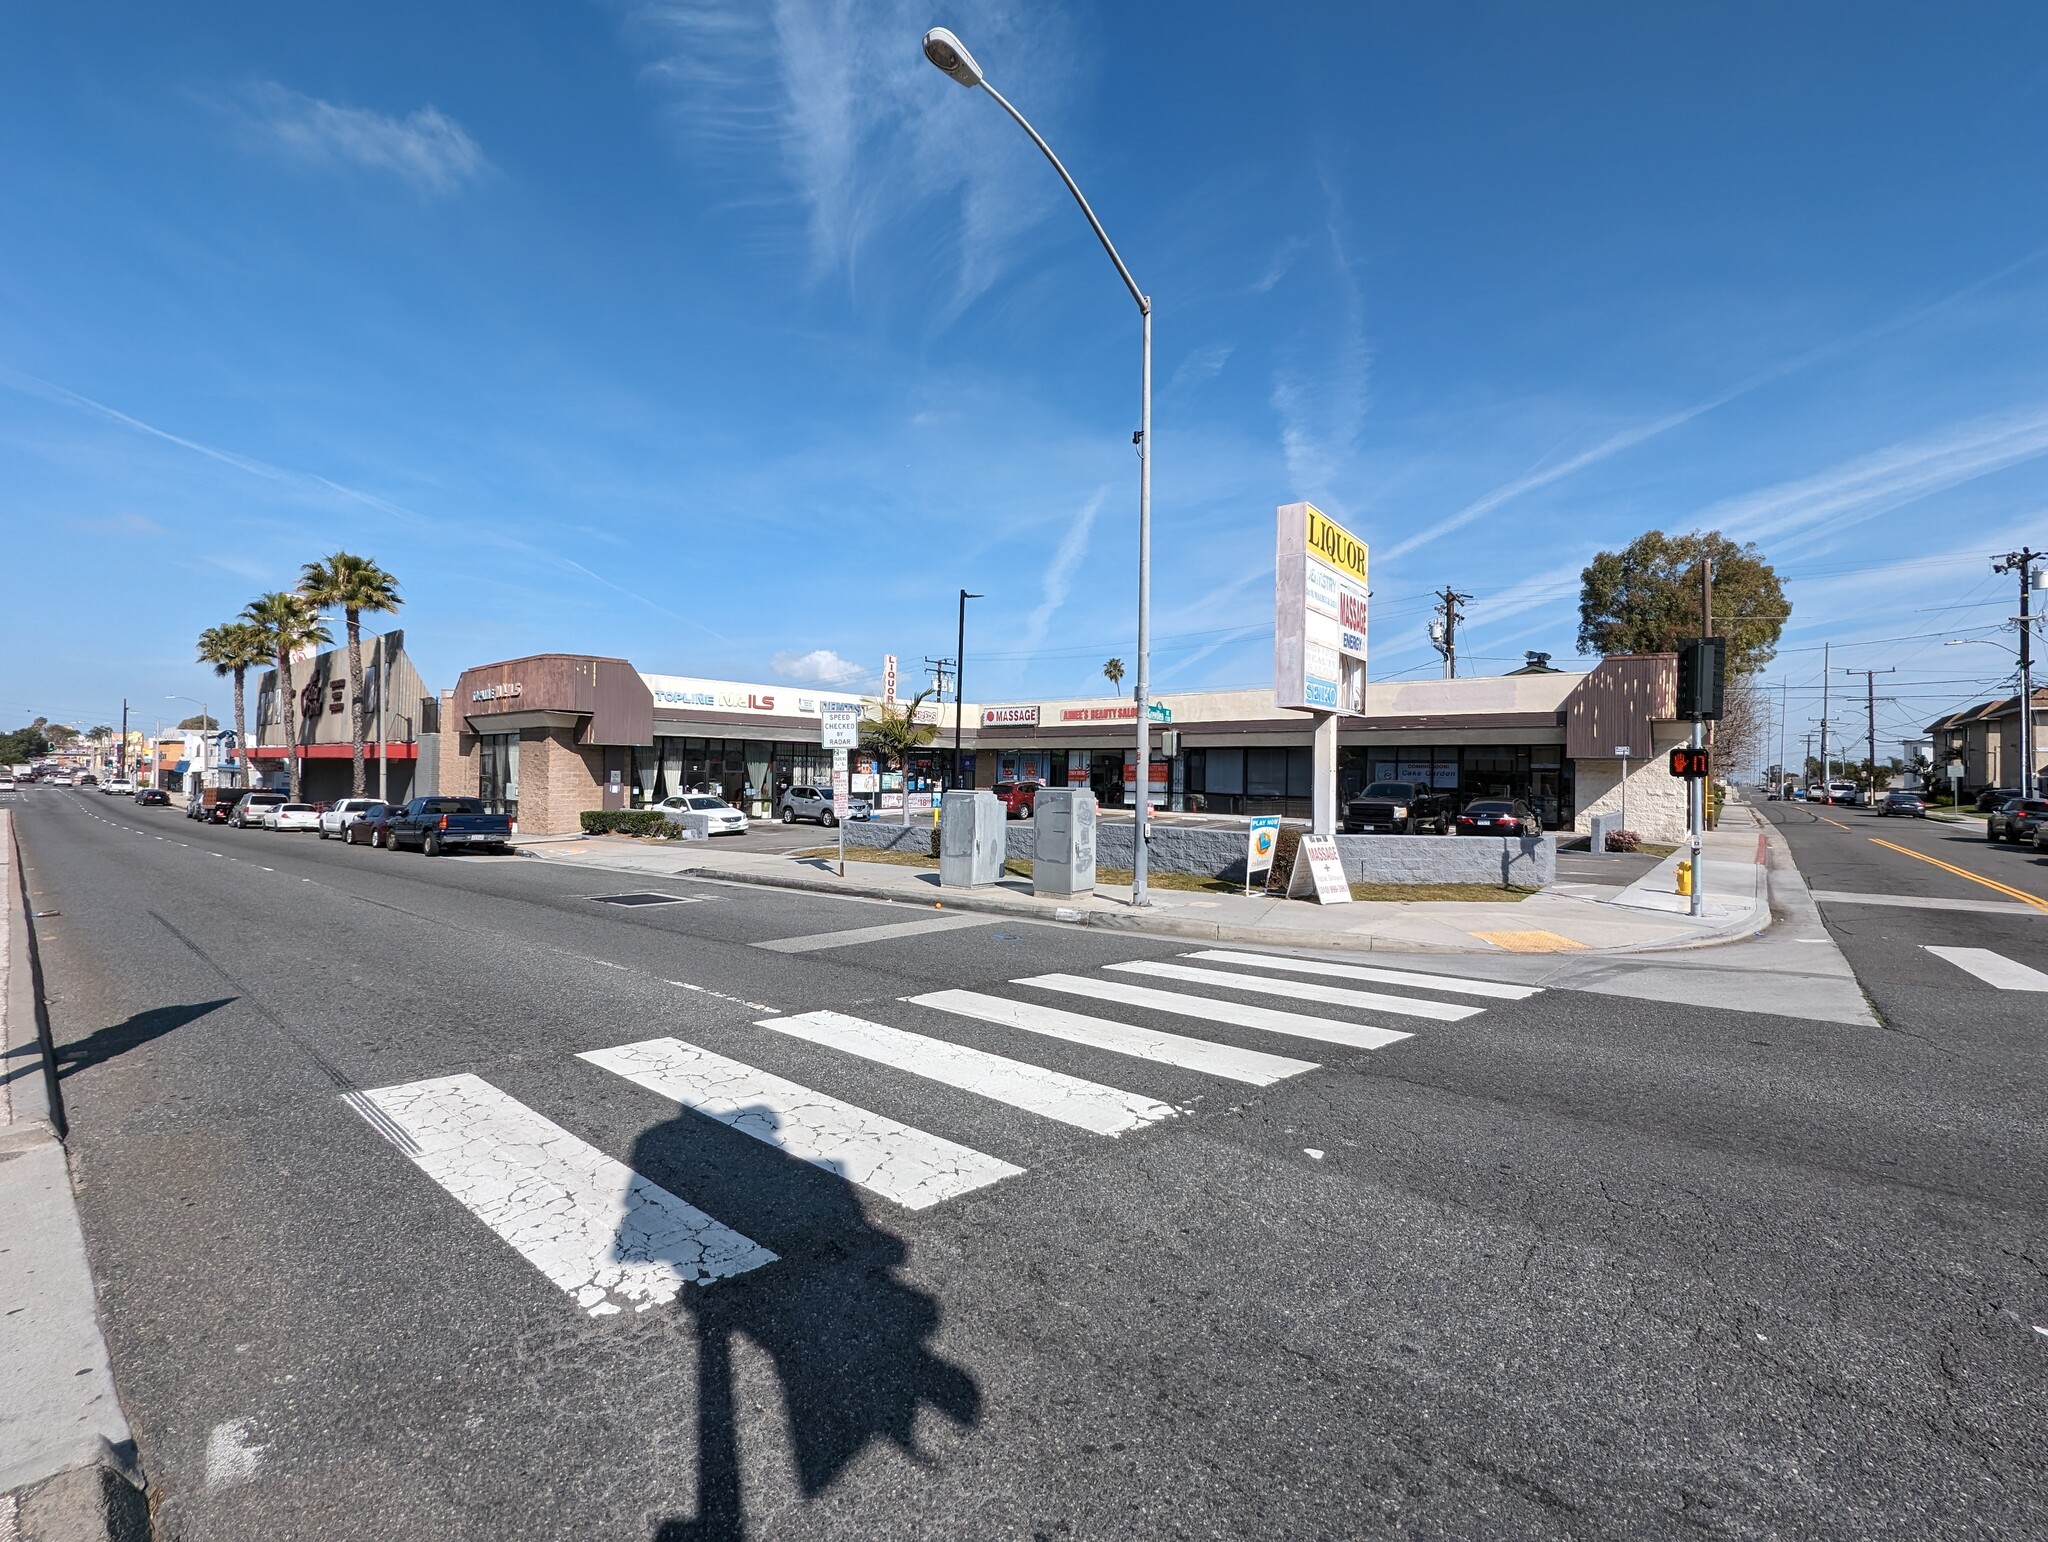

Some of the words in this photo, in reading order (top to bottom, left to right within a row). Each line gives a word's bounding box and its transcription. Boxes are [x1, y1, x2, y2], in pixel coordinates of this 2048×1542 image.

[1308, 513, 1366, 577] LIQUOR
[1339, 591, 1367, 636] MASSAGE
[1343, 632, 1363, 652] ENERGY
[887, 655, 896, 704] LIQUOR
[655, 690, 715, 706] TOPLINE
[1306, 682, 1337, 705] SEIKO
[996, 709, 1036, 722] MASSAGE
[1090, 708, 1117, 719] BEAUTY
[1117, 707, 1138, 718] SALO
[1693, 755, 1705, 772] 17
[1401, 769, 1422, 777] Cake
[1252, 819, 1266, 827] PLAY
[1266, 818, 1278, 826] NOW
[1308, 846, 1339, 862] MASSAGE
